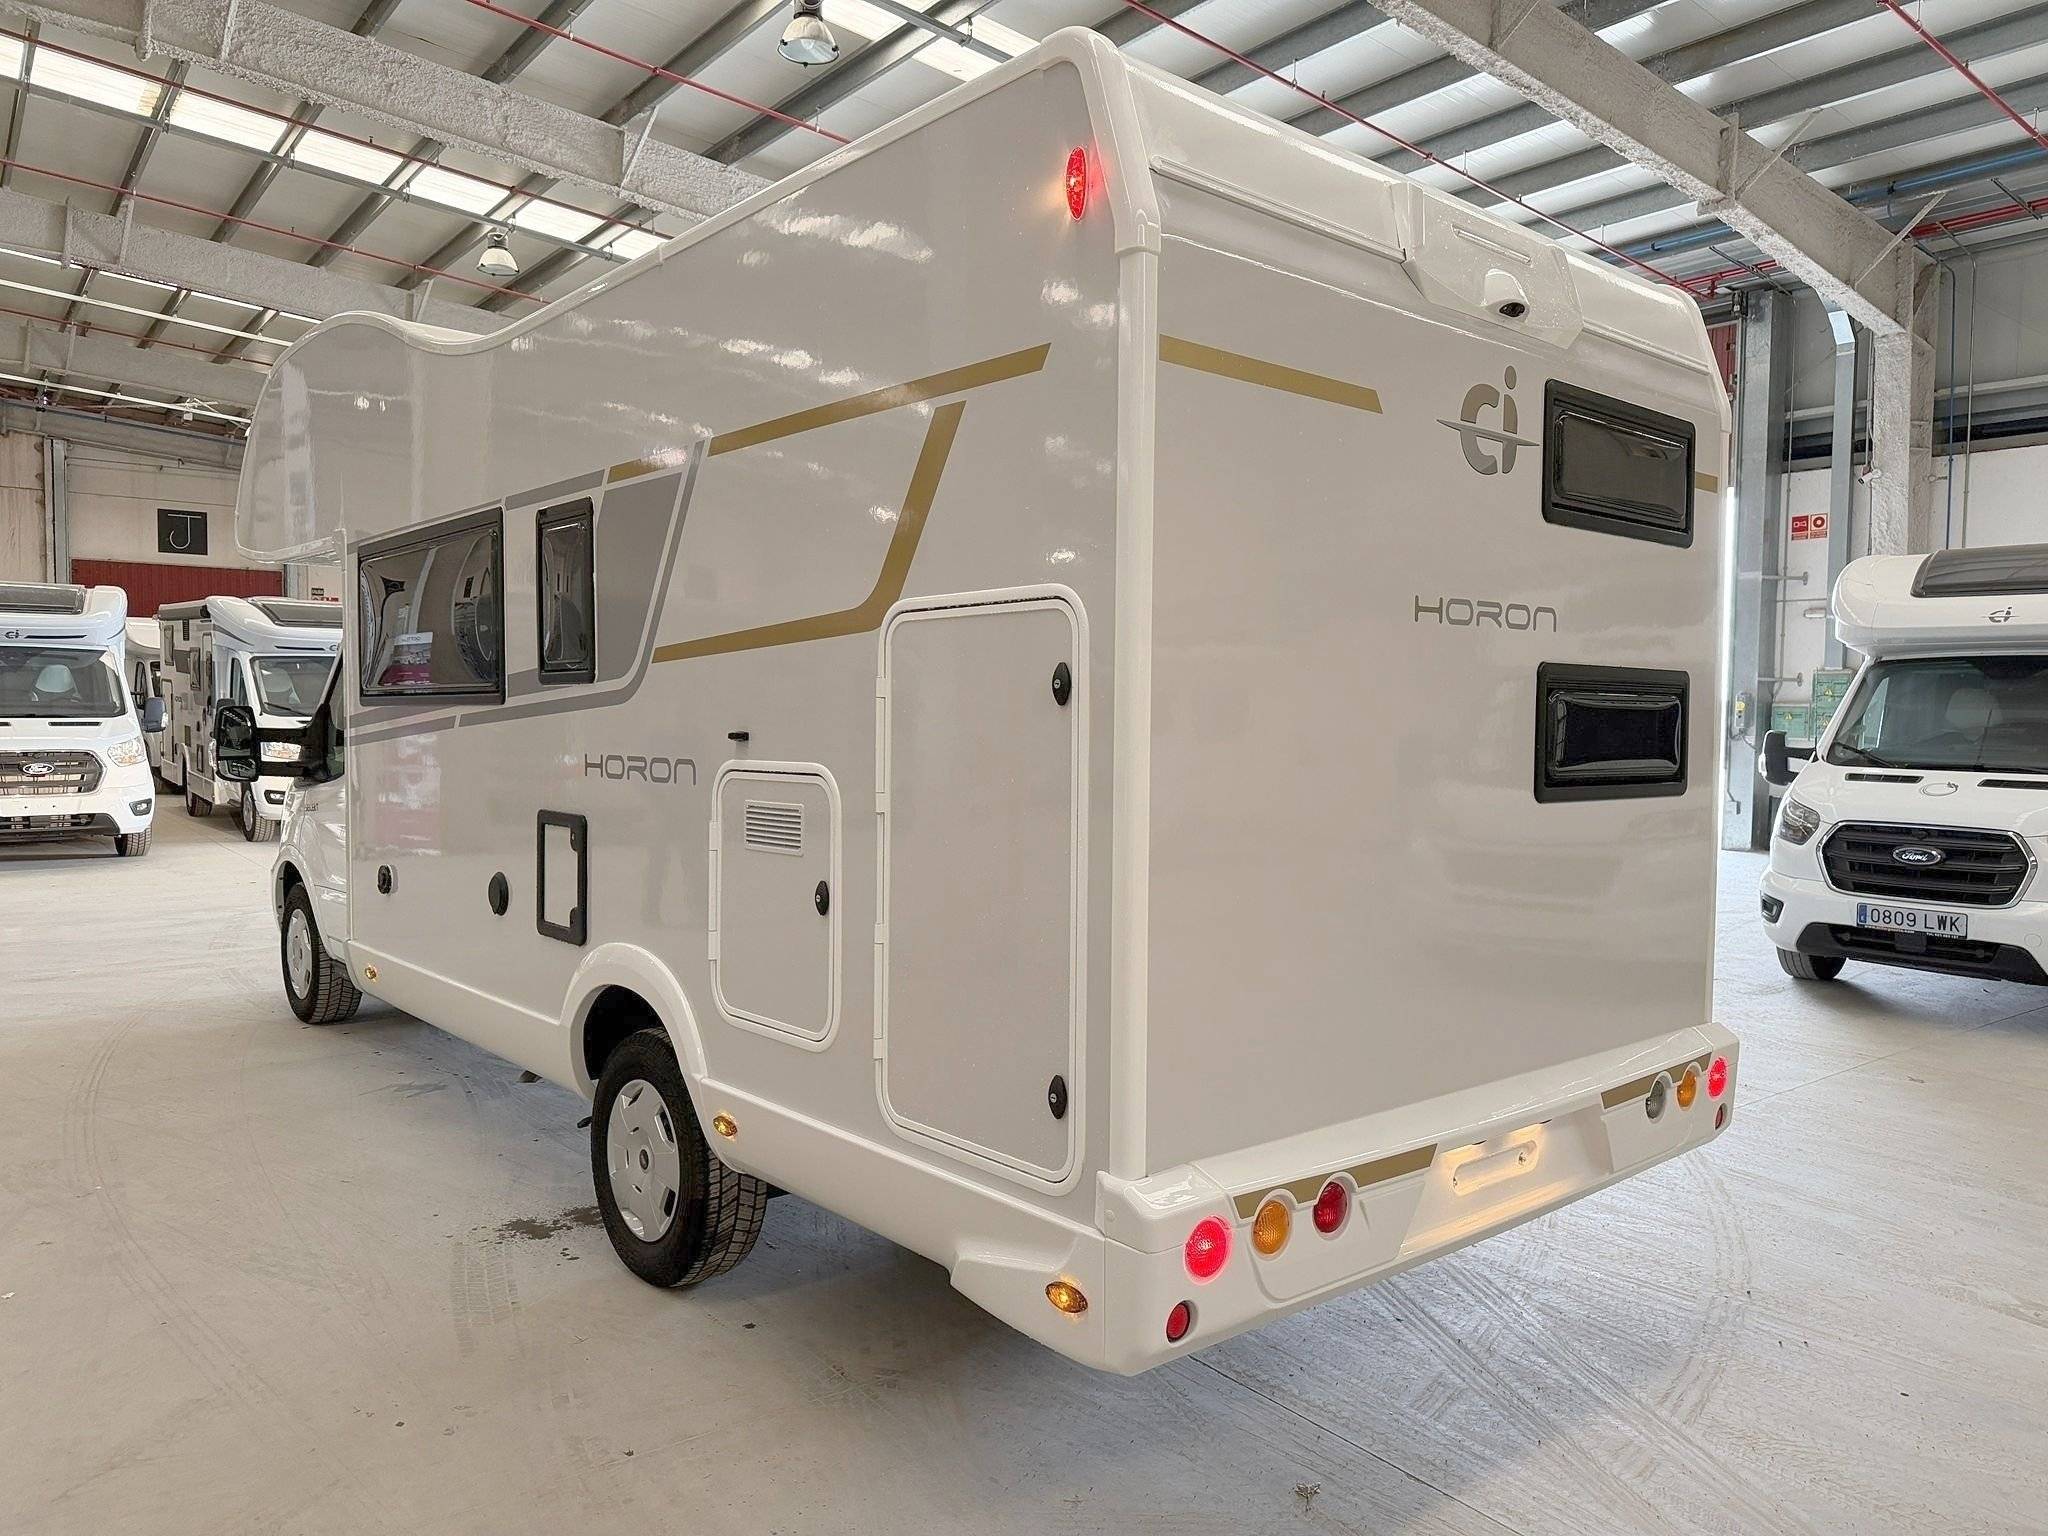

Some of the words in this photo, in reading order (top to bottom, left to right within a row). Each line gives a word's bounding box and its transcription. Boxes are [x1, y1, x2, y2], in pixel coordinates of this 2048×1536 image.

[167, 513, 202, 549] J
[1414, 595, 1557, 633] HORON
[584, 753, 697, 785] HORON
[1901, 851, 1929, 862] Ford
[1870, 908, 1917, 927] 0809
[1924, 913, 1961, 933] LWK
